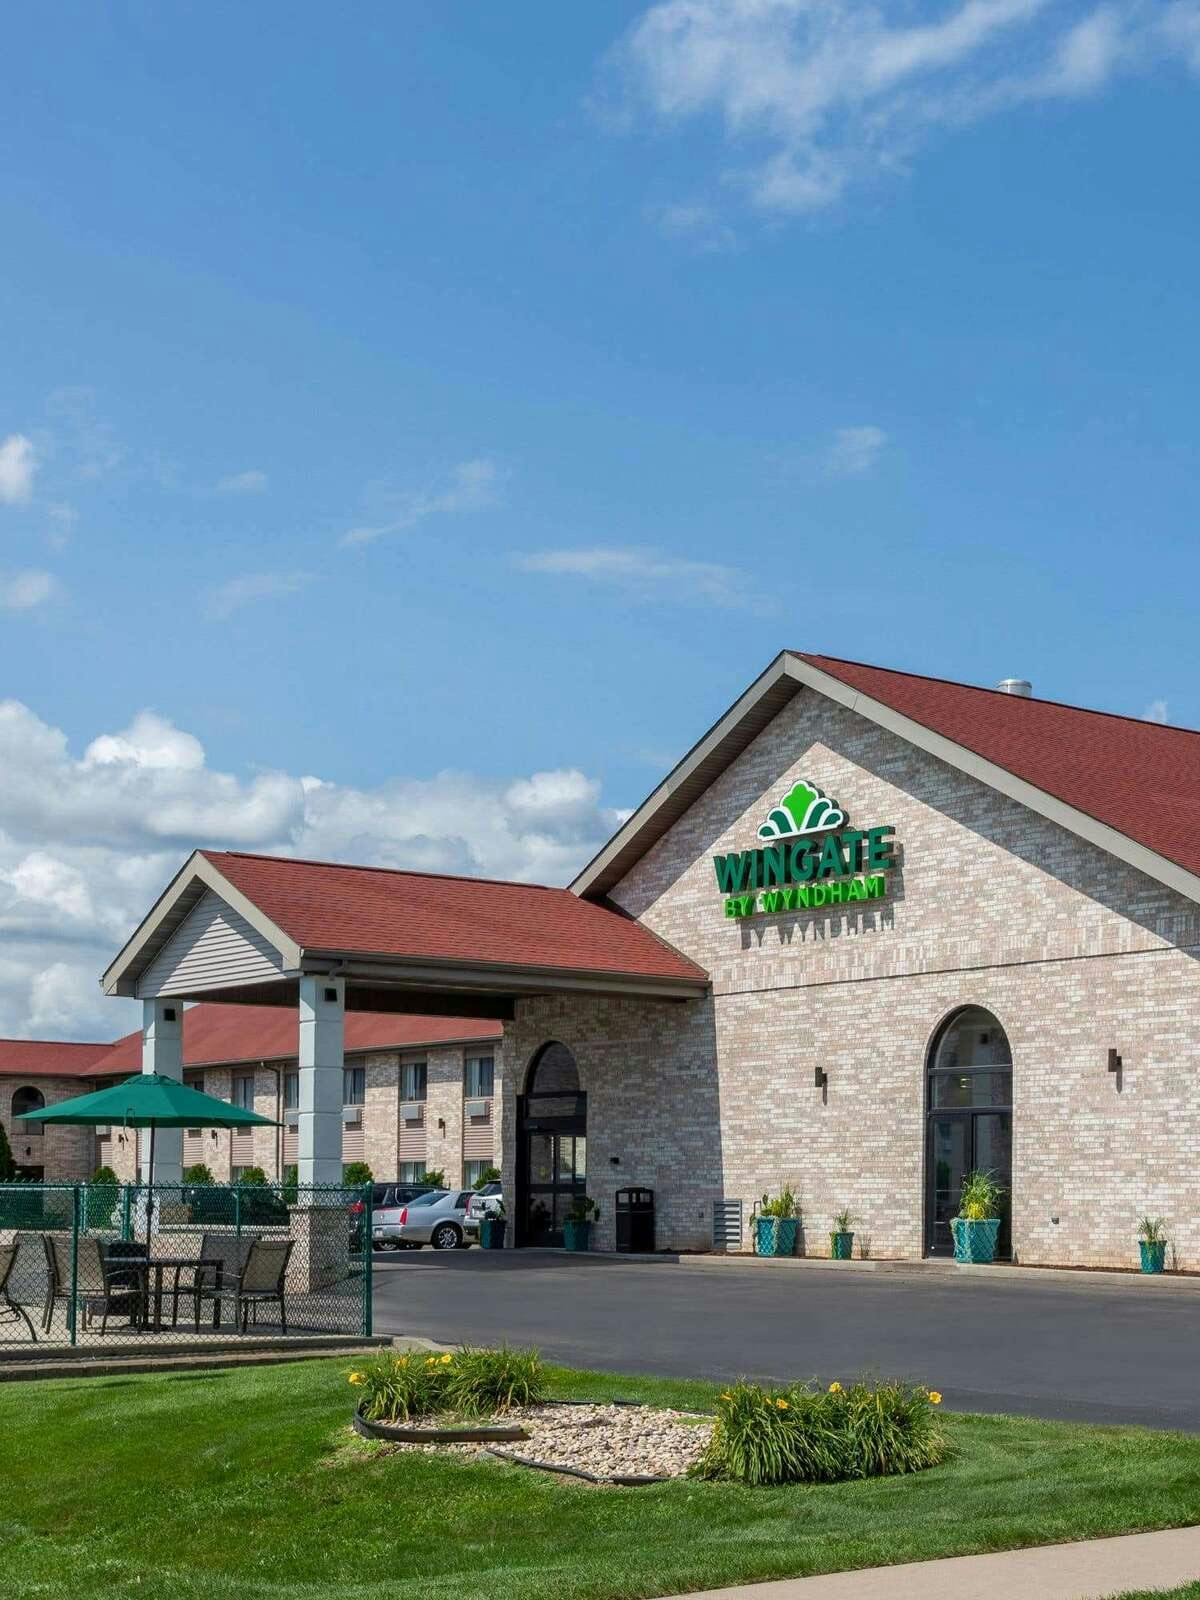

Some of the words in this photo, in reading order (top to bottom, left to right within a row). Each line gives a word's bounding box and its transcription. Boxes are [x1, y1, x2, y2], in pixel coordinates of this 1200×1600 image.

[713, 825, 894, 894] WINGATE
[724, 896, 754, 919] BY
[762, 876, 885, 913] WYNDHAM
